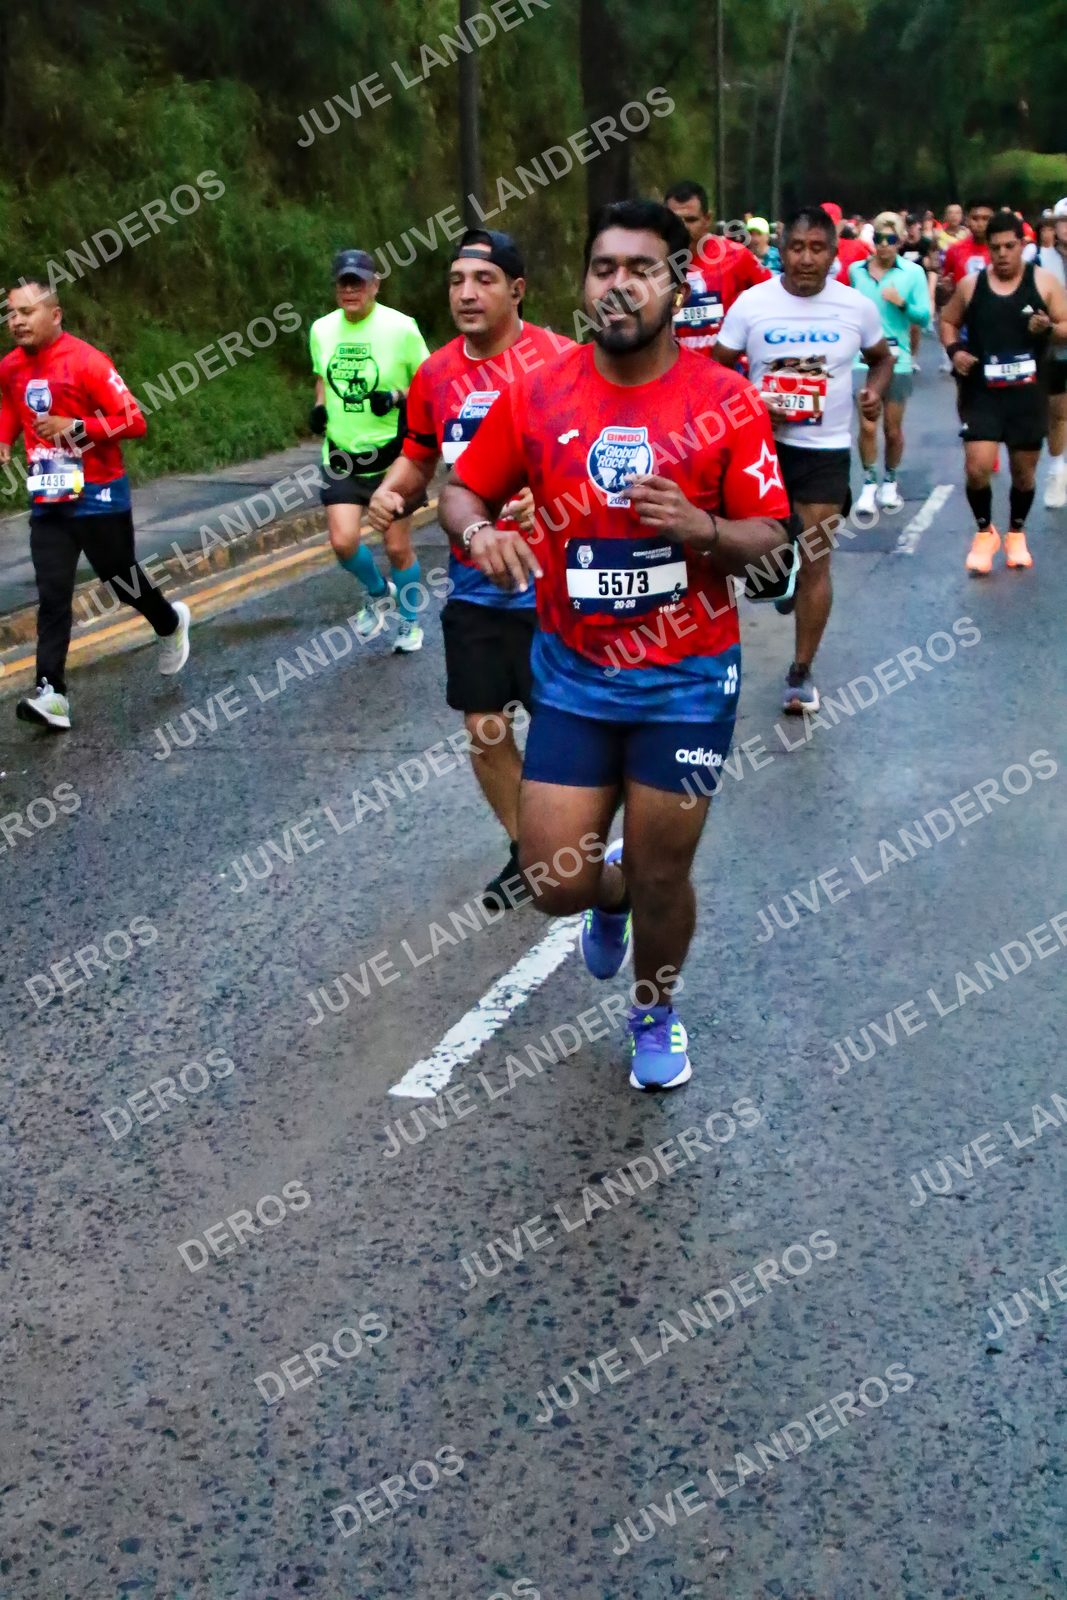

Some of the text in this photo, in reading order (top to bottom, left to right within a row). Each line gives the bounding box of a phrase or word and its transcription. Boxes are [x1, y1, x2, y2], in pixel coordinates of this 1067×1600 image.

[764, 327, 840, 344] Gato
[606, 433, 641, 442] BIMBO
[605, 445, 639, 458] Global
[597, 455, 626, 468] Race
[609, 496, 629, 505] 2026
[598, 570, 649, 596] 5573
[675, 747, 722, 767] adidas
